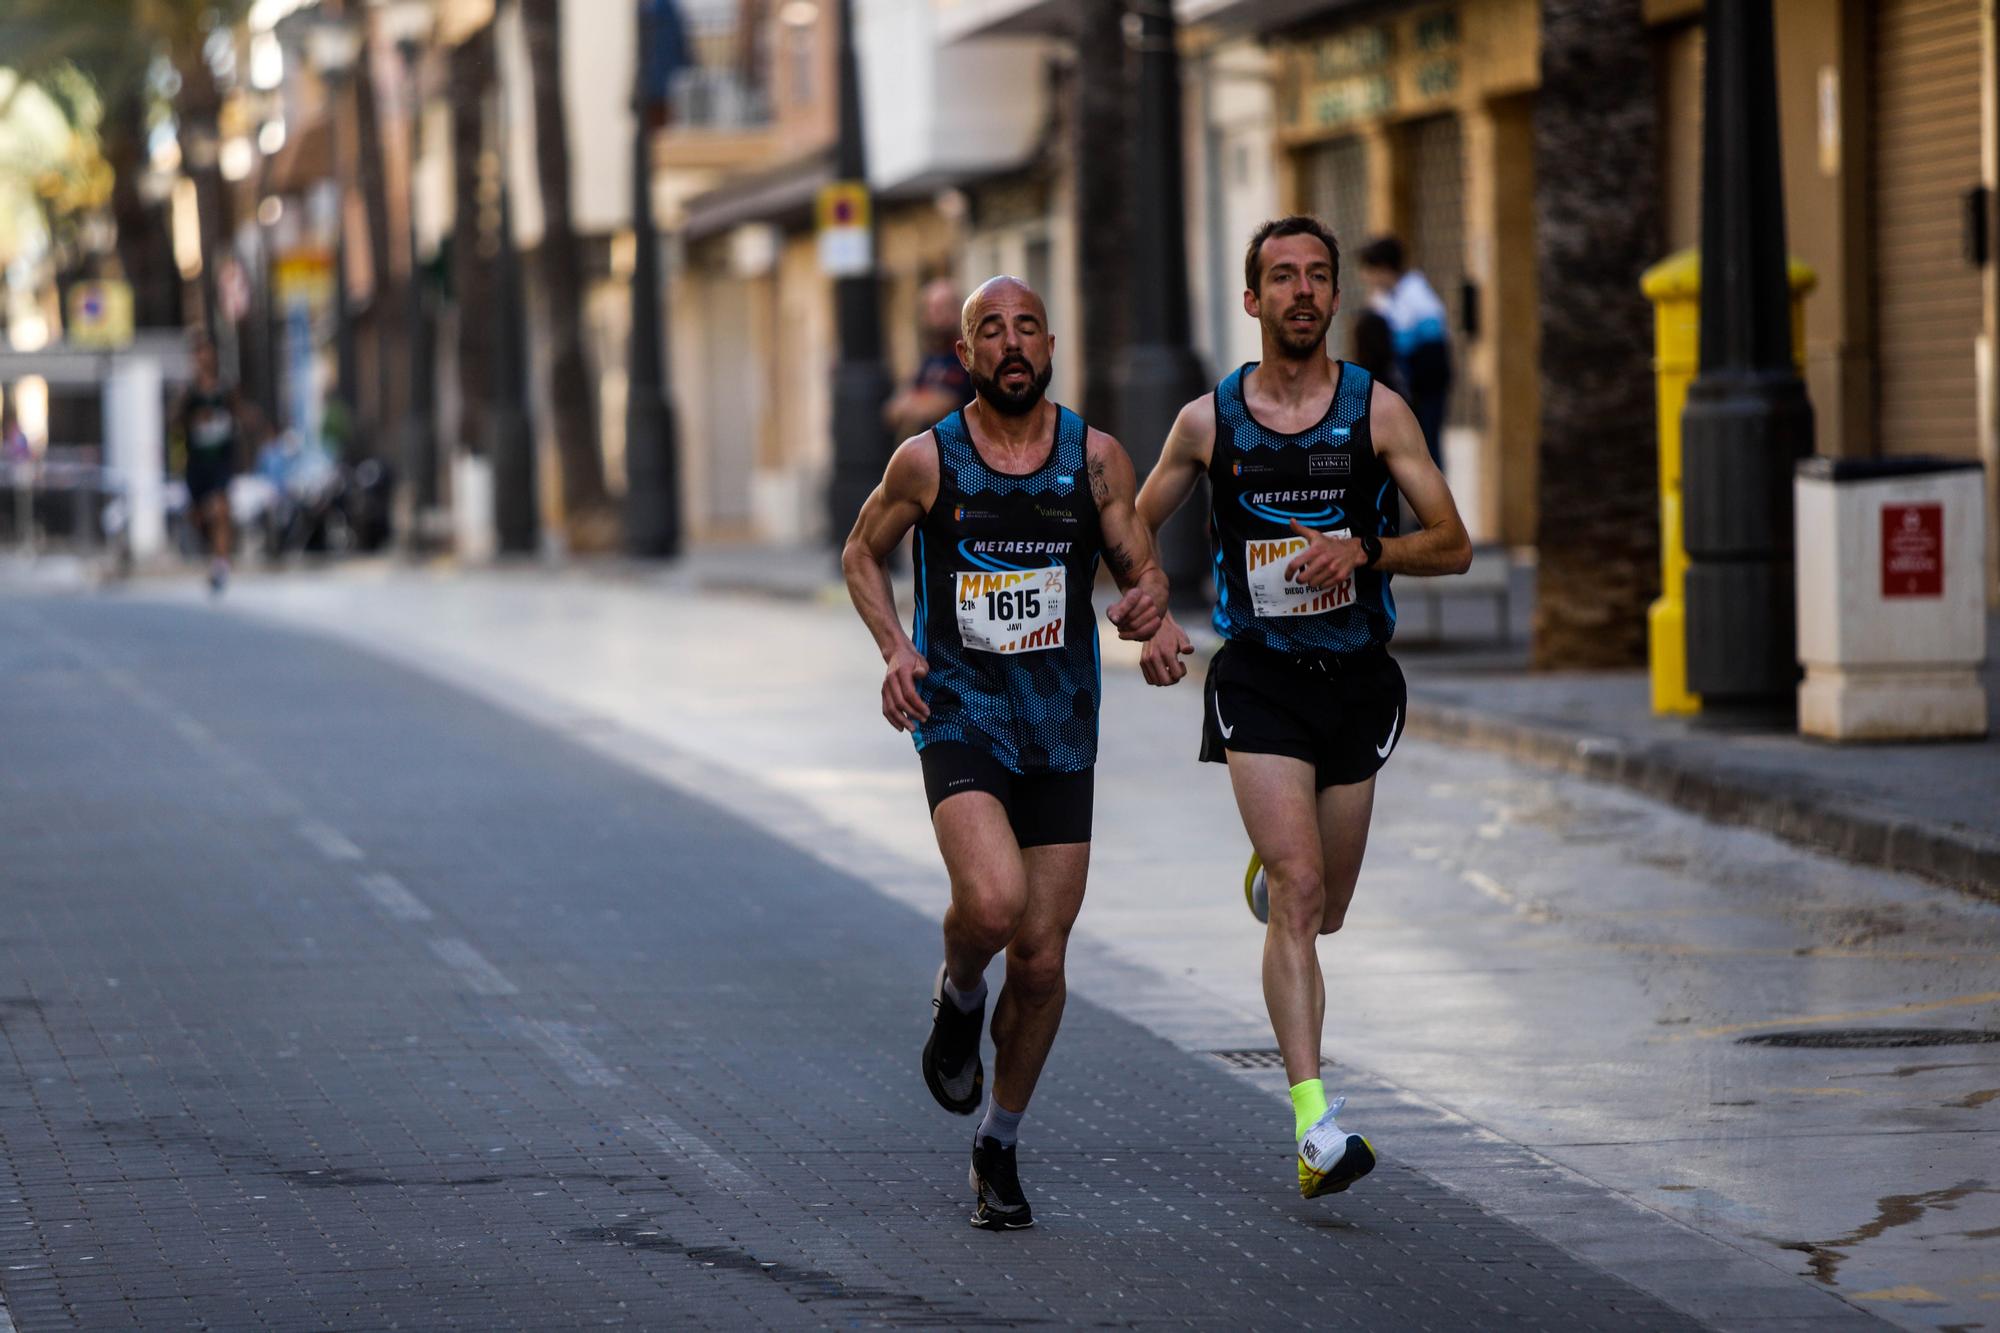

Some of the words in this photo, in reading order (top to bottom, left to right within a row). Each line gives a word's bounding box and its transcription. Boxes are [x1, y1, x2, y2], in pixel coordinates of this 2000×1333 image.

[1252, 489, 1346, 504] METAESPORT
[973, 541, 1073, 554] METAESPORT
[1284, 586, 1304, 595] DIEGO
[985, 588, 1040, 621] 1615
[1006, 623, 1022, 632] JAVI
